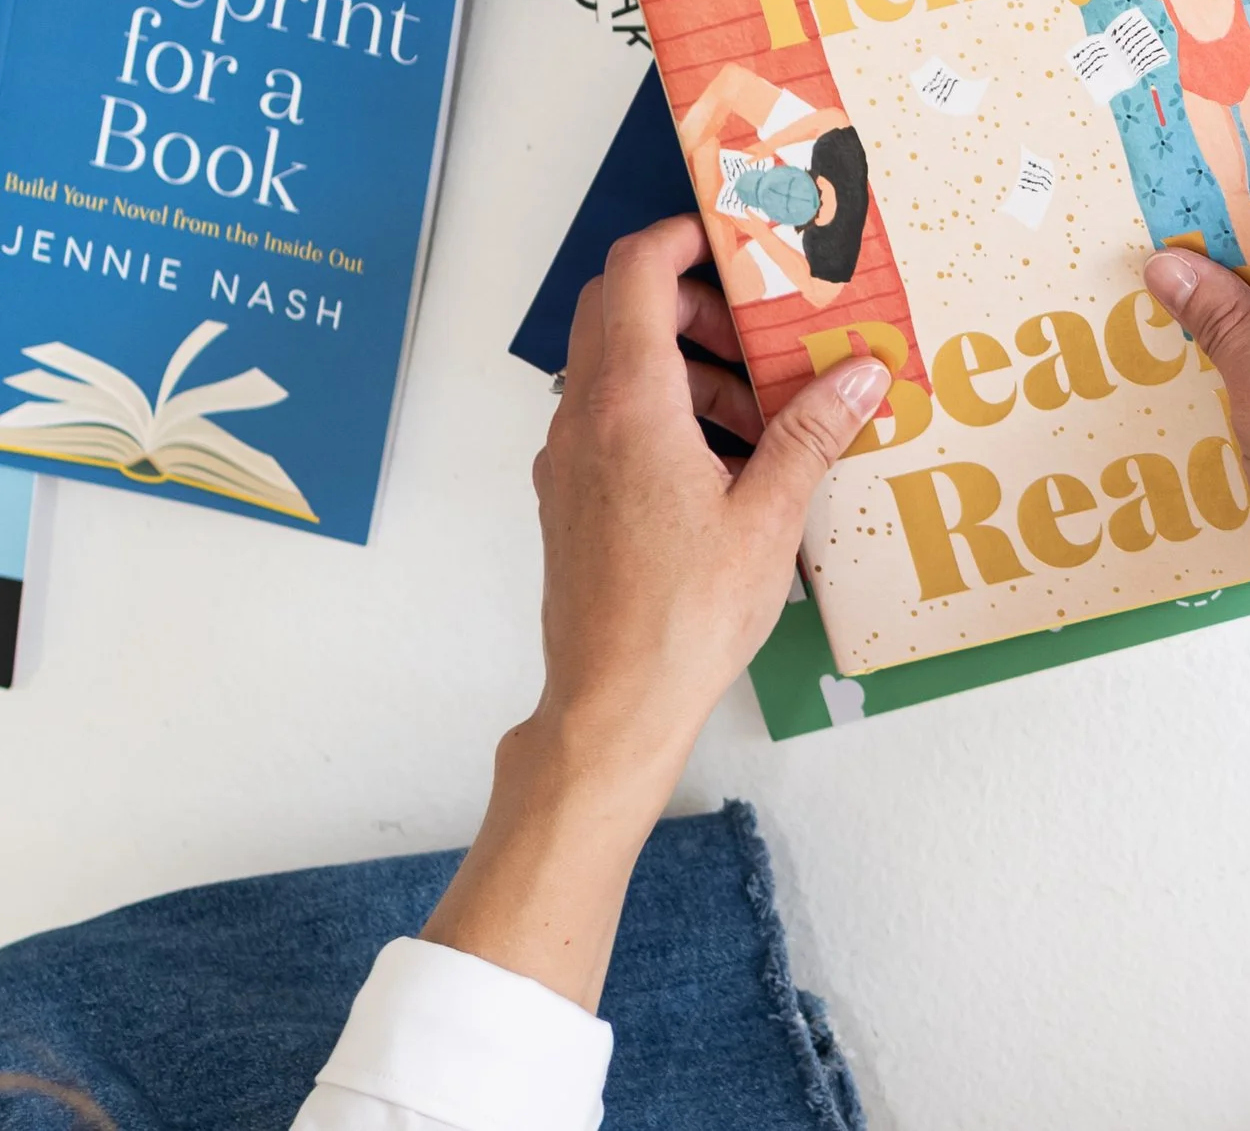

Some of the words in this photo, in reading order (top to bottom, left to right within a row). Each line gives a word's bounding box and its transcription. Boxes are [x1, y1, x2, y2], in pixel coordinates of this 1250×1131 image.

[116, 6, 239, 104] for
[259, 67, 305, 125] a
[90, 94, 308, 214] Book
[1, 225, 183, 292] JENNIE
[210, 269, 344, 331] NASH
[4, 170, 58, 203] Build
[63, 184, 109, 213] Your
[112, 196, 169, 226] Novel
[173, 208, 222, 239] from
[225, 222, 259, 249] the
[264, 231, 325, 264] Inside
[329, 248, 365, 275] Out
